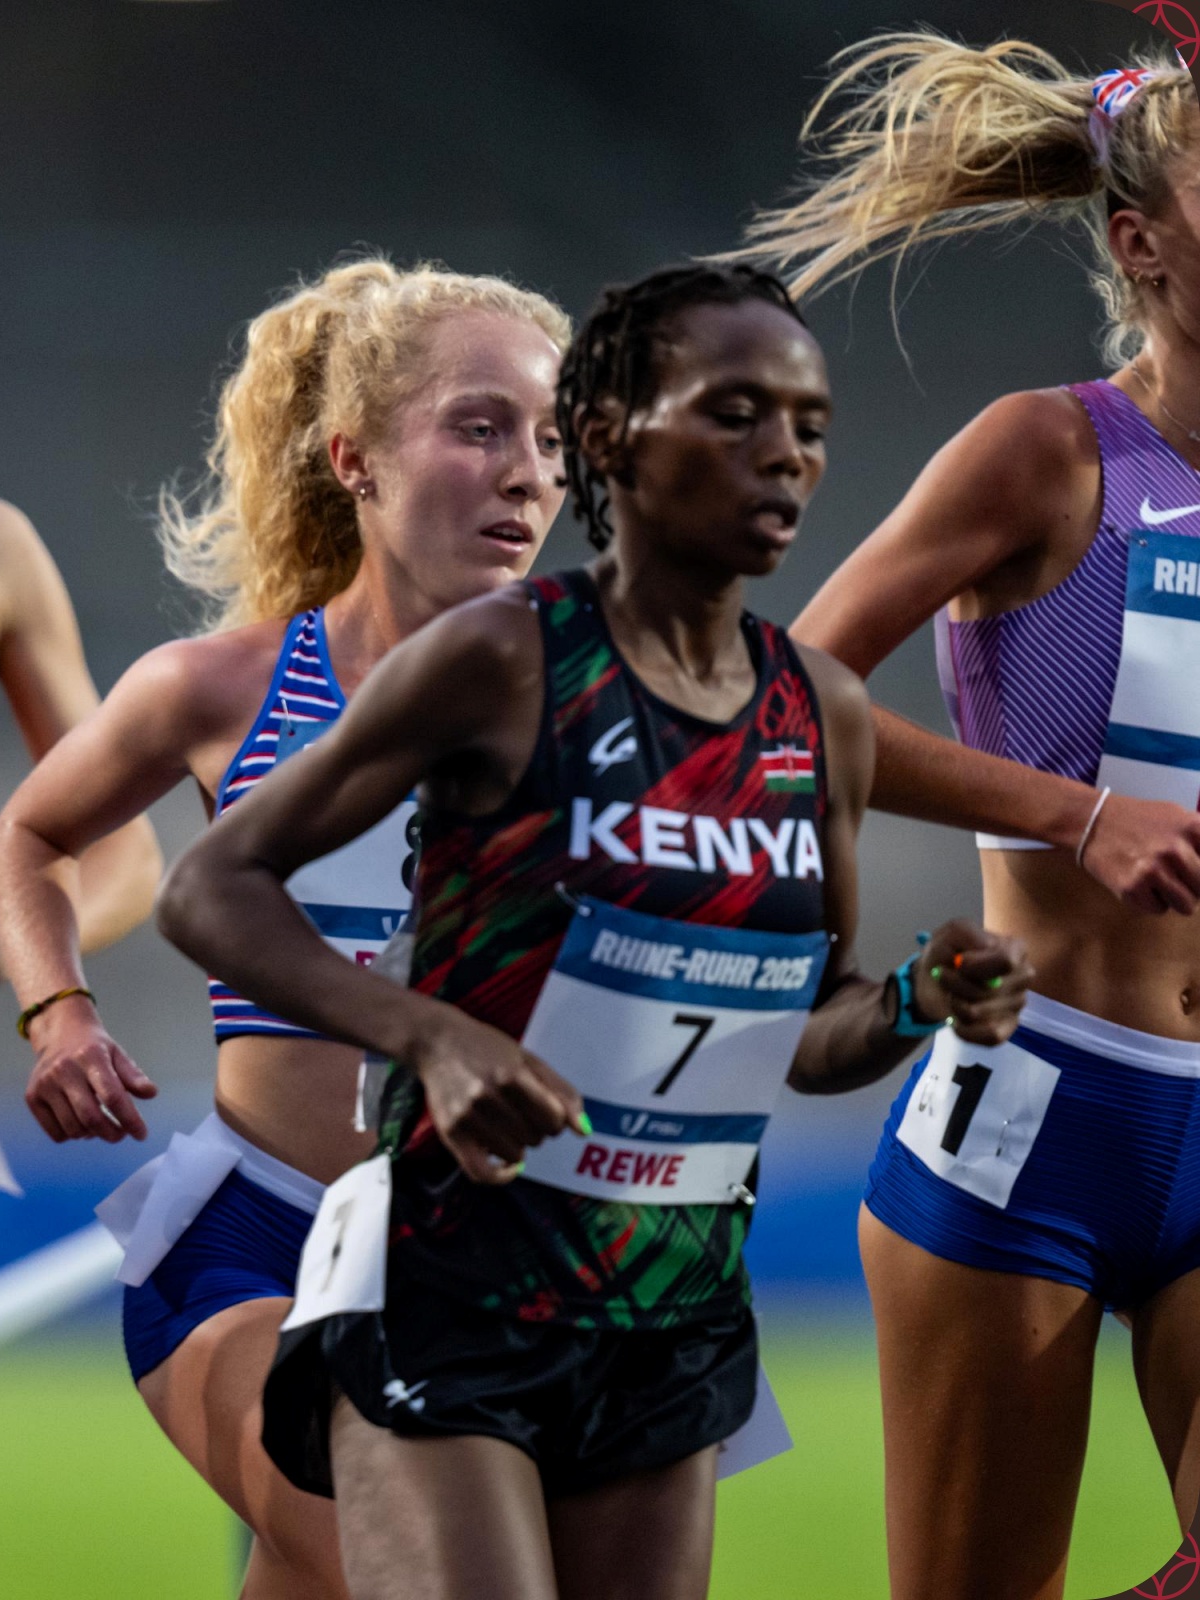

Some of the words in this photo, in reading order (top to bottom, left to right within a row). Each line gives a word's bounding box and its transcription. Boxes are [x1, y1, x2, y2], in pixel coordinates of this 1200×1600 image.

[568, 796, 824, 882] KENYA
[590, 928, 760, 991] RHINE-RUHR
[754, 956, 814, 992] 2025
[652, 1012, 715, 1096] 7
[940, 1062, 993, 1157] 1
[576, 1142, 686, 1188] REWE
